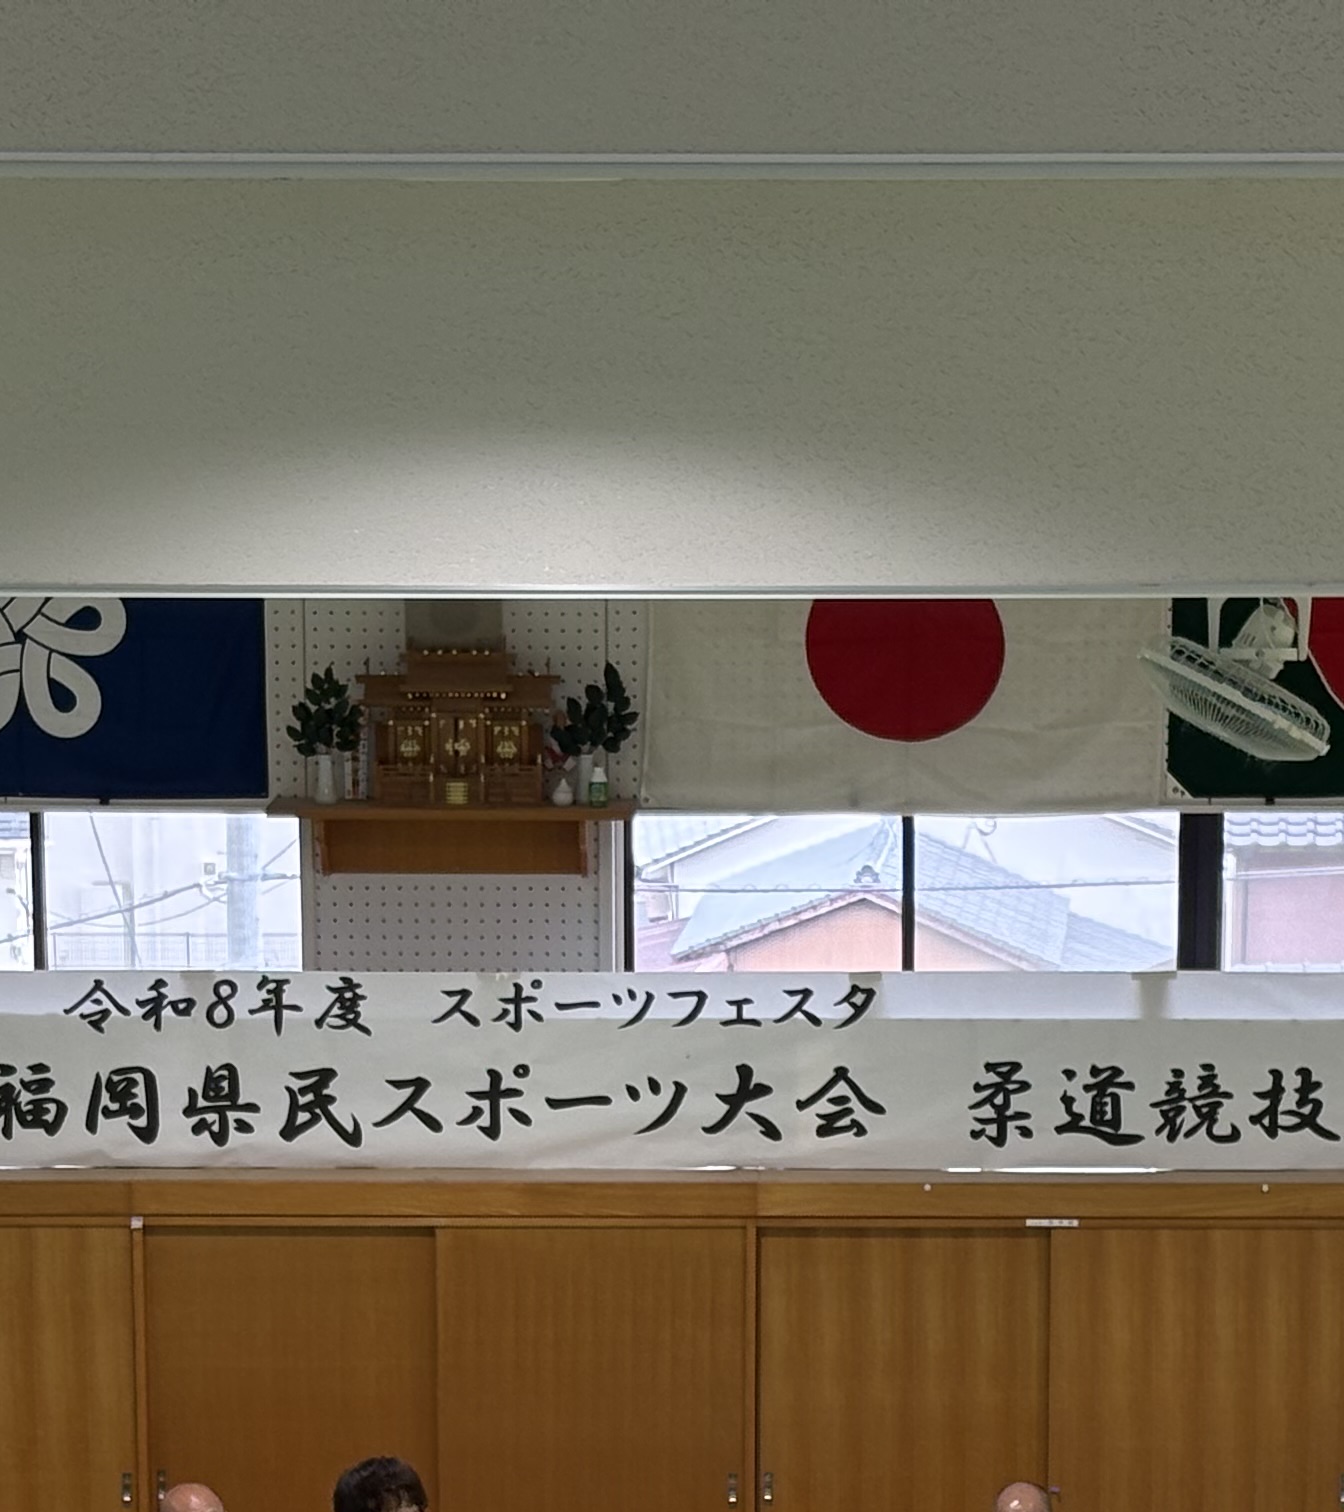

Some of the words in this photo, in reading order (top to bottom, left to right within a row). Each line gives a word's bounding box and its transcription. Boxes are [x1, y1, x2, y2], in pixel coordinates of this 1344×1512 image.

[63, 975, 372, 1036] 令和8年度
[431, 978, 877, 1033] スポーツフェスタ
[967, 1061, 1341, 1148] 柔道競技
